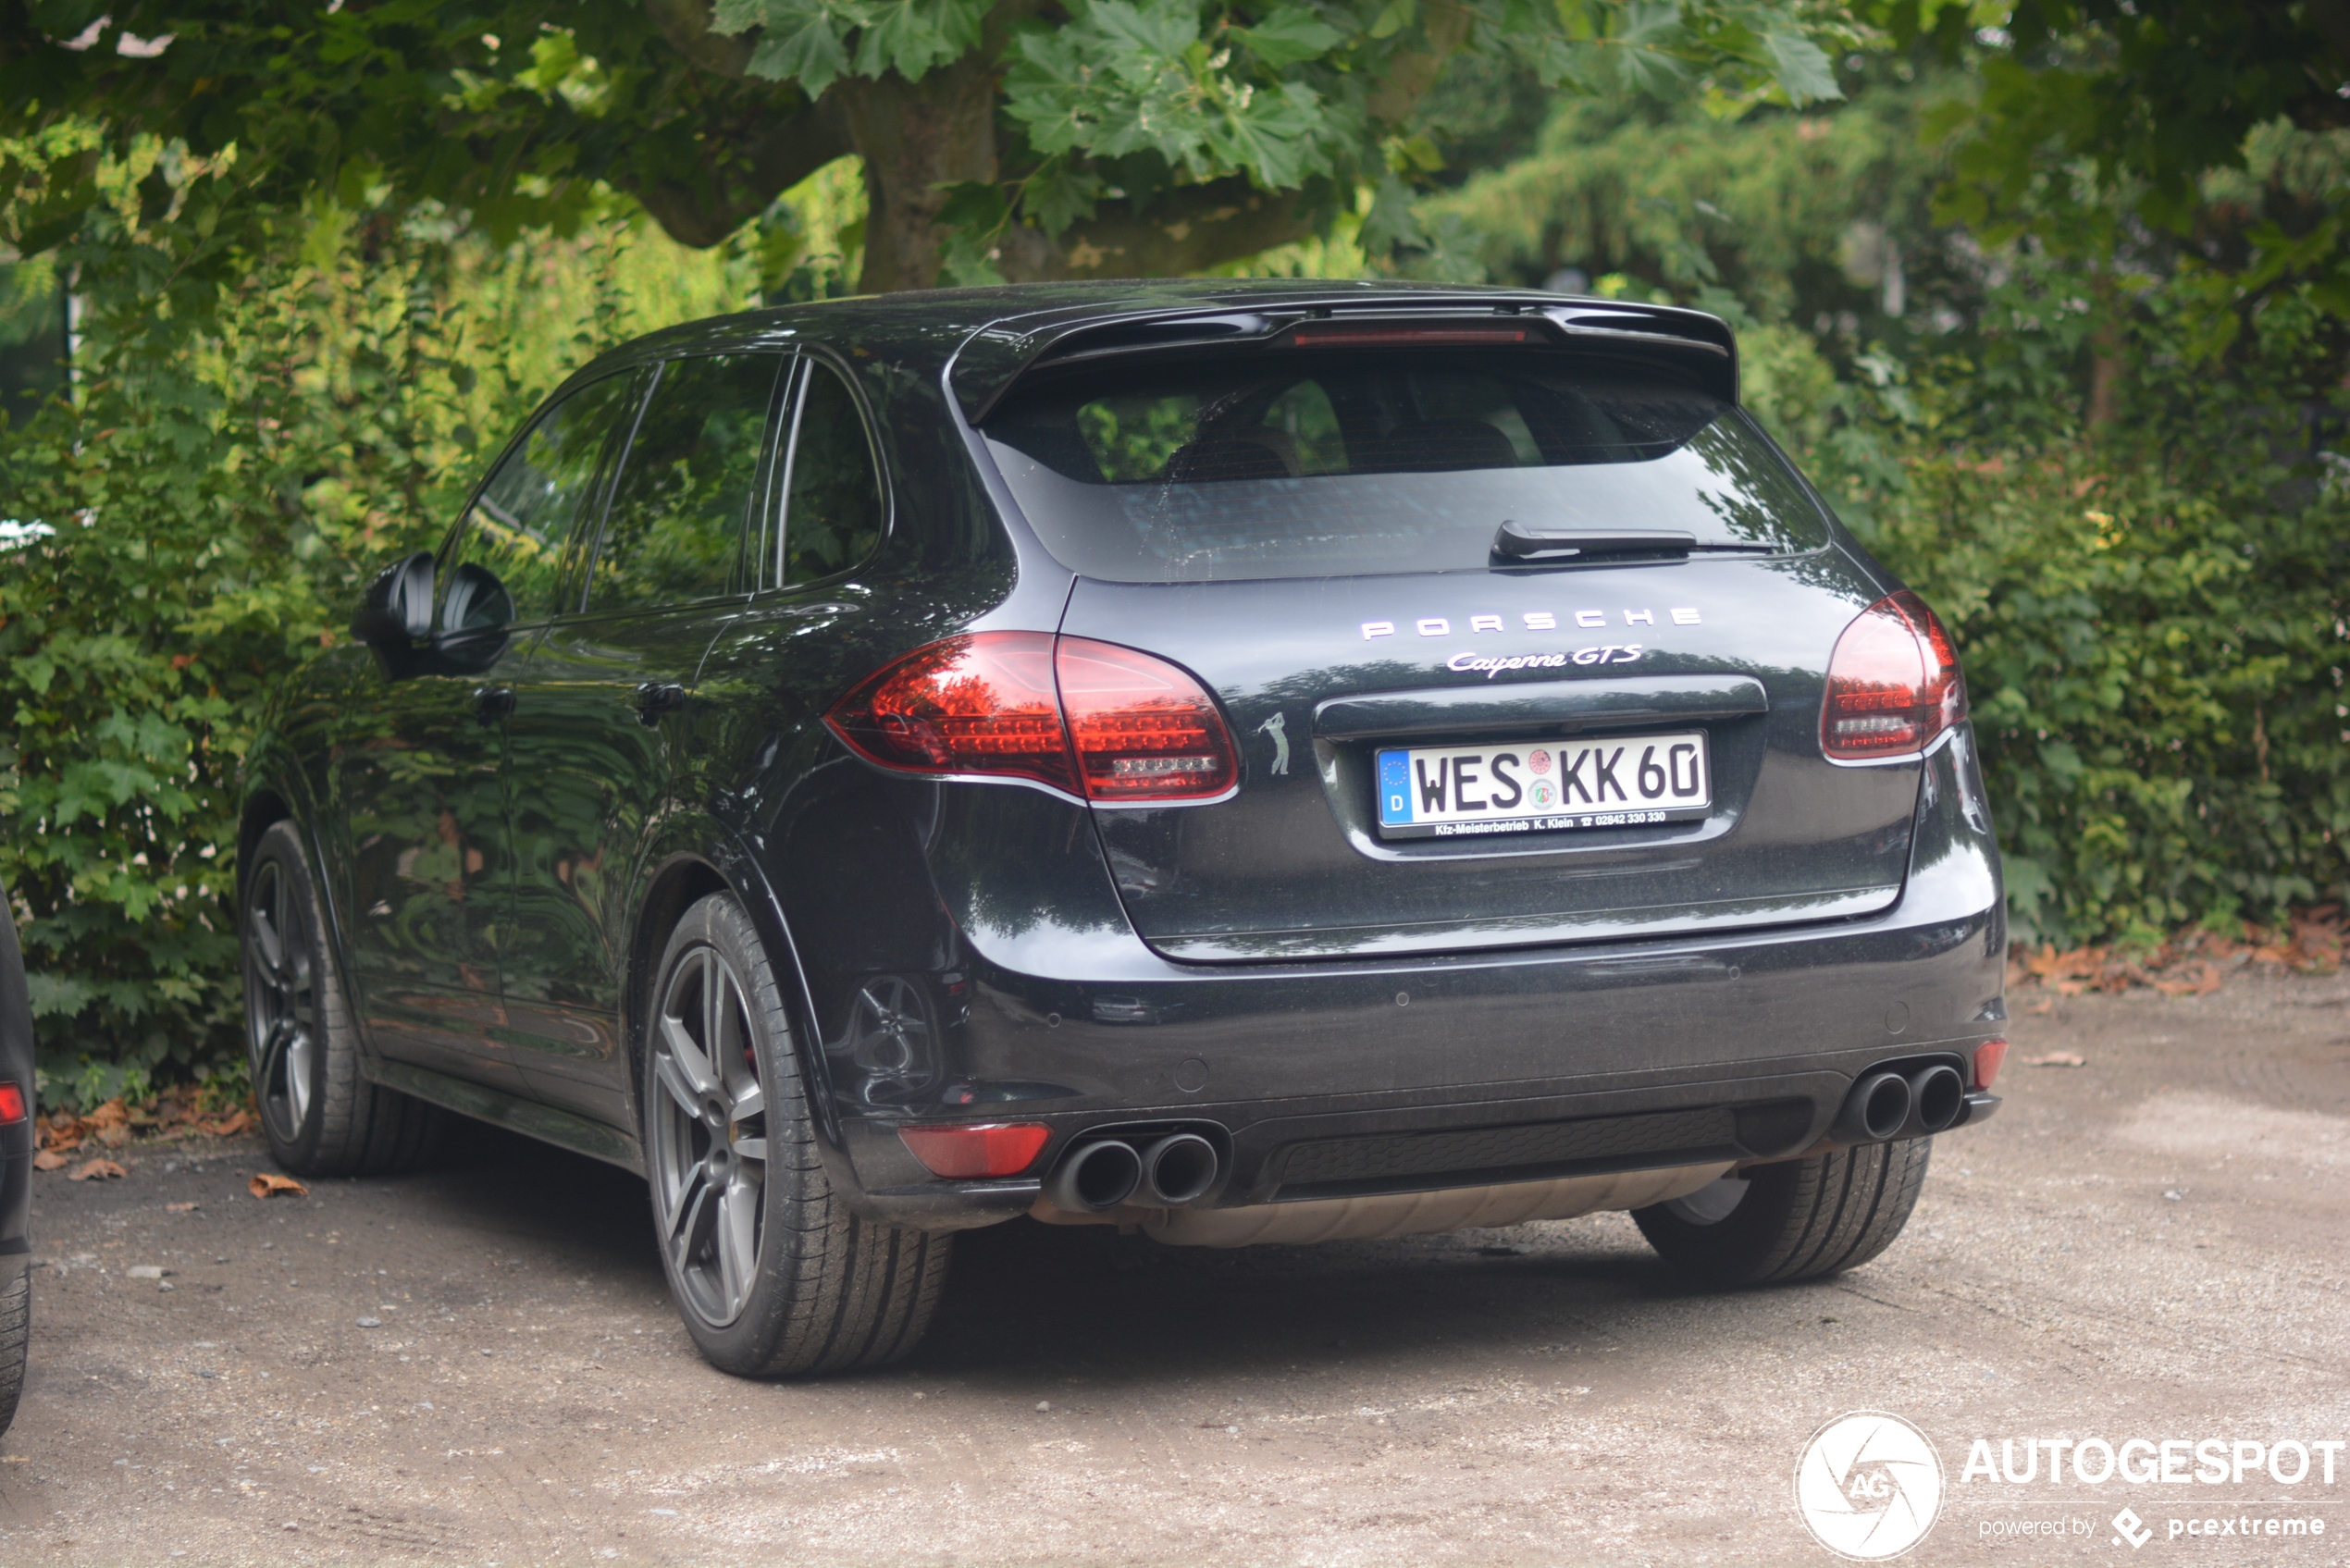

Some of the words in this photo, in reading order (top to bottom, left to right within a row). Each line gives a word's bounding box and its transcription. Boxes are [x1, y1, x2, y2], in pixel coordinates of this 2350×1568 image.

[1361, 608, 1701, 640] PORSCHE
[1446, 651, 1566, 678] Cayenne
[1572, 644, 1642, 666] GTS
[1416, 752, 1523, 813] WES
[1560, 747, 1628, 805] KK
[1638, 743, 1700, 800] 60
[1391, 795, 1404, 811] D
[1435, 821, 1529, 835] Kfz-Meisterbetrieb
[1534, 820, 1546, 830] K.
[1548, 818, 1574, 829] Klein
[1595, 814, 1626, 826] 02842
[1627, 813, 1645, 824] 330
[1648, 812, 1665, 823] 330
